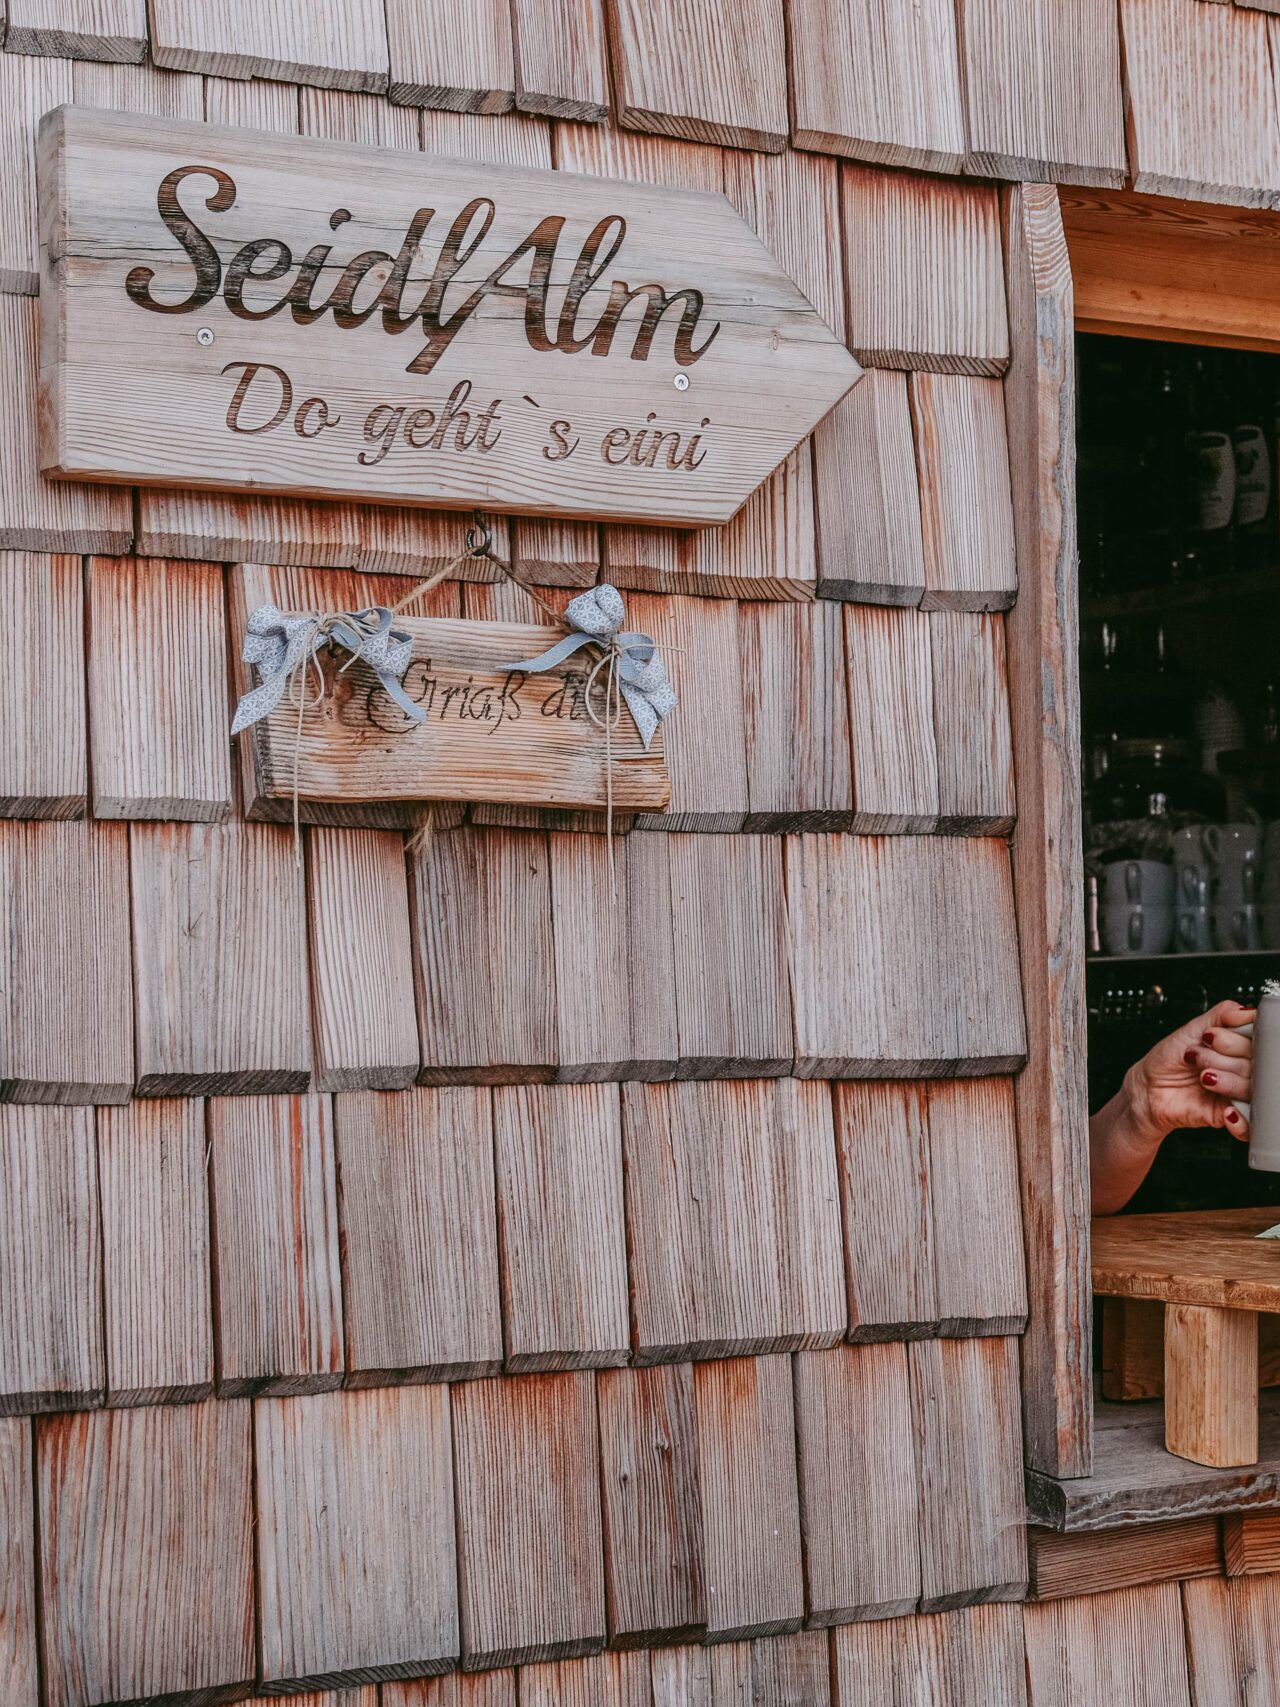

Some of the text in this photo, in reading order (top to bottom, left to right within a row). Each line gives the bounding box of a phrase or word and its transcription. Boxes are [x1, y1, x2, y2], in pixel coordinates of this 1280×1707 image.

[125, 165, 721, 375] SeidlAlm
[221, 361, 341, 437] Do
[357, 379, 502, 466] geht
[600, 412, 711, 472] eini
